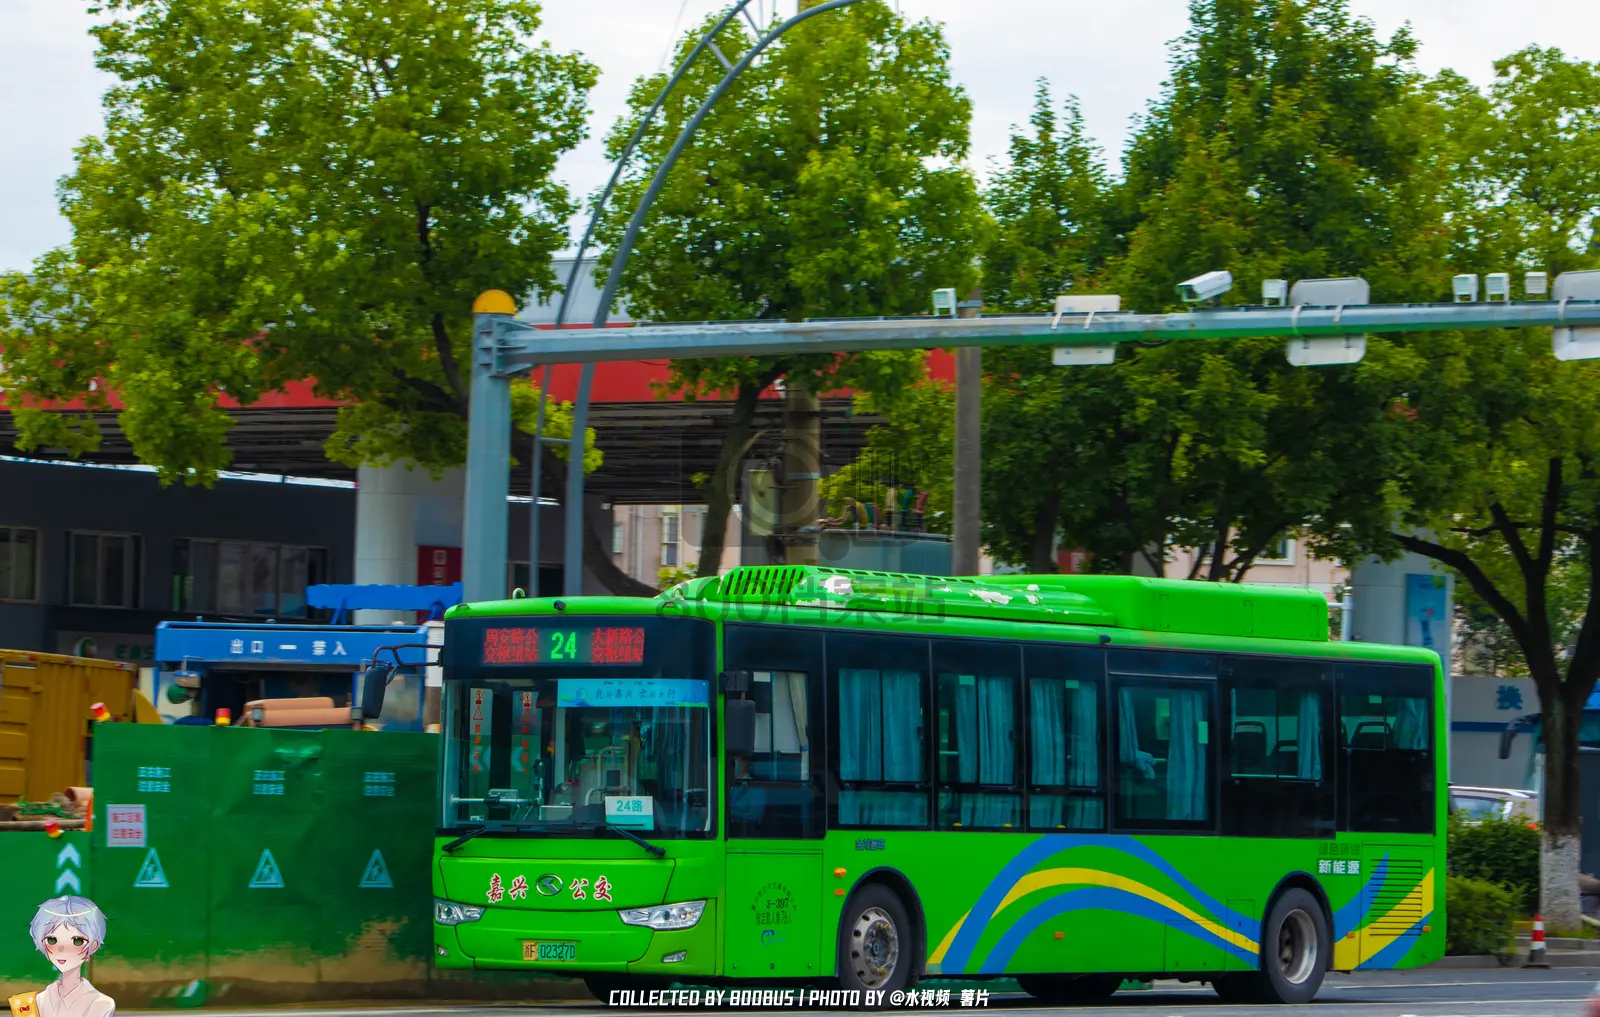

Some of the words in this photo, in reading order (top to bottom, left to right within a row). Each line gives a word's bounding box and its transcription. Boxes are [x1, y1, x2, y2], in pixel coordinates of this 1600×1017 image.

[550, 631, 577, 660] 24
[616, 799, 643, 812] 24路
[1318, 859, 1360, 875] 新能源
[485, 873, 530, 903] 嘉兴
[568, 874, 613, 902] 公交
